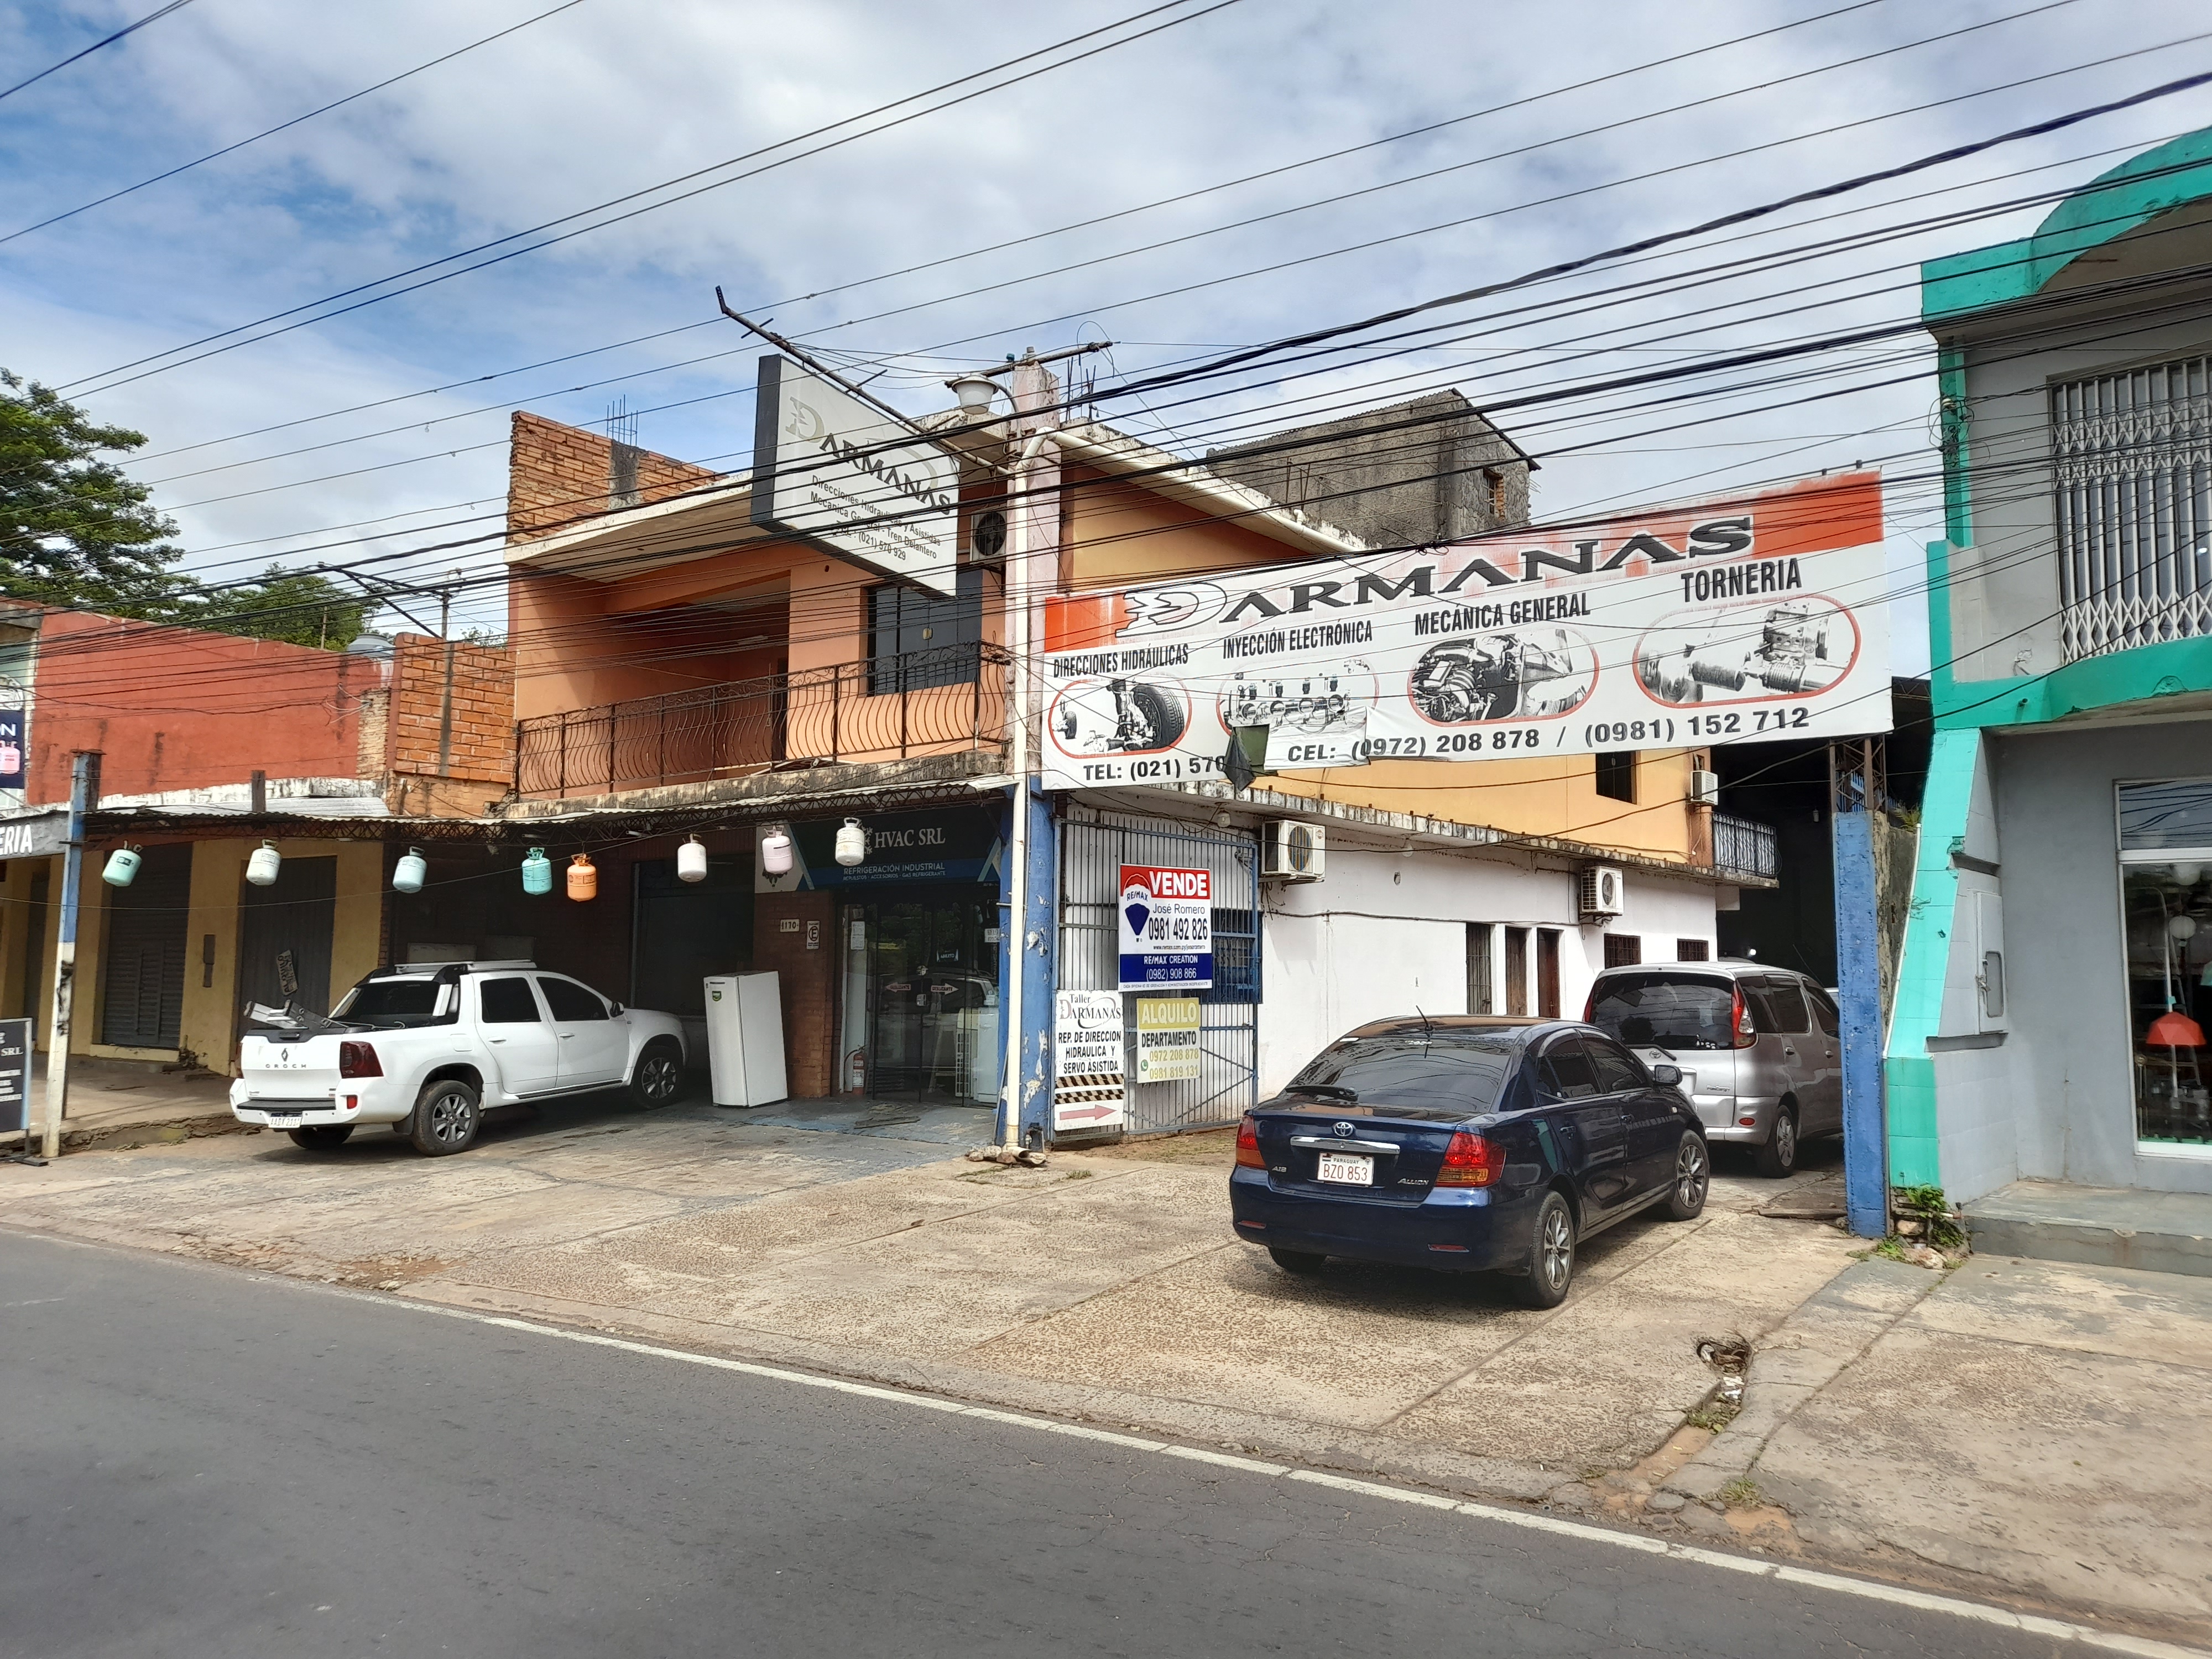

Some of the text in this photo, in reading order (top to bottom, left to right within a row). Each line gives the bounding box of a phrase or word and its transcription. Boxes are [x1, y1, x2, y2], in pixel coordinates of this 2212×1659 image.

[812, 474, 859, 505] Direcciones
[910, 525, 941, 546] Asistidas
[811, 491, 848, 518] Mecanica
[888, 528, 902, 541] Tren
[905, 536, 937, 559] Delantero
[859, 531, 877, 549] (021)
[894, 549, 906, 561] 929
[1681, 557, 1802, 603] TORNERIA
[1415, 592, 1591, 636] MECÁNICA GENERAL
[1223, 620, 1373, 659] INYECCIÓN ELECTRÓNICA
[1053, 643, 1189, 678] DIRECCIONES HIDRÁULICAS
[1288, 744, 1335, 762] CEL:
[1352, 737, 1427, 760] (0972)
[1436, 733, 1483, 753] 208
[1493, 729, 1540, 750] 878
[1585, 718, 1674, 748] (0981)
[1688, 713, 1741, 736] 152
[1752, 707, 1810, 731] 712
[1084, 762, 1122, 781] TEL:
[1130, 758, 1181, 782] (021)
[874, 828, 946, 848] HVAC SRL
[844, 862, 946, 875] REFRIGERACIÓN INDUSTRIAL
[1149, 871, 1208, 896] VENDE
[1127, 891, 1148, 901] RE/MAX
[1152, 903, 1205, 914] José Romero
[1149, 917, 1208, 940] 0981 492 826
[1144, 955, 1198, 964] RE/MAX CREATION
[1146, 968, 1197, 982] (0982) 908 866
[1069, 994, 1091, 1003] Taller
[1059, 999, 1121, 1019] DARMANAS
[1141, 1003, 1197, 1025] ALQUILO
[1058, 1031, 1121, 1044] REP. DE DIRECCION
[1141, 1031, 1197, 1047] DEPARTAMENTO
[1066, 1045, 1115, 1058] HIDRAULICA Y
[1150, 1048, 1199, 1062] 0972 208 878
[1063, 1060, 1118, 1074] SERVO ASISTIDA
[1150, 1065, 1198, 1079] 0981 819 131
[1348, 1166, 1368, 1181] 853
